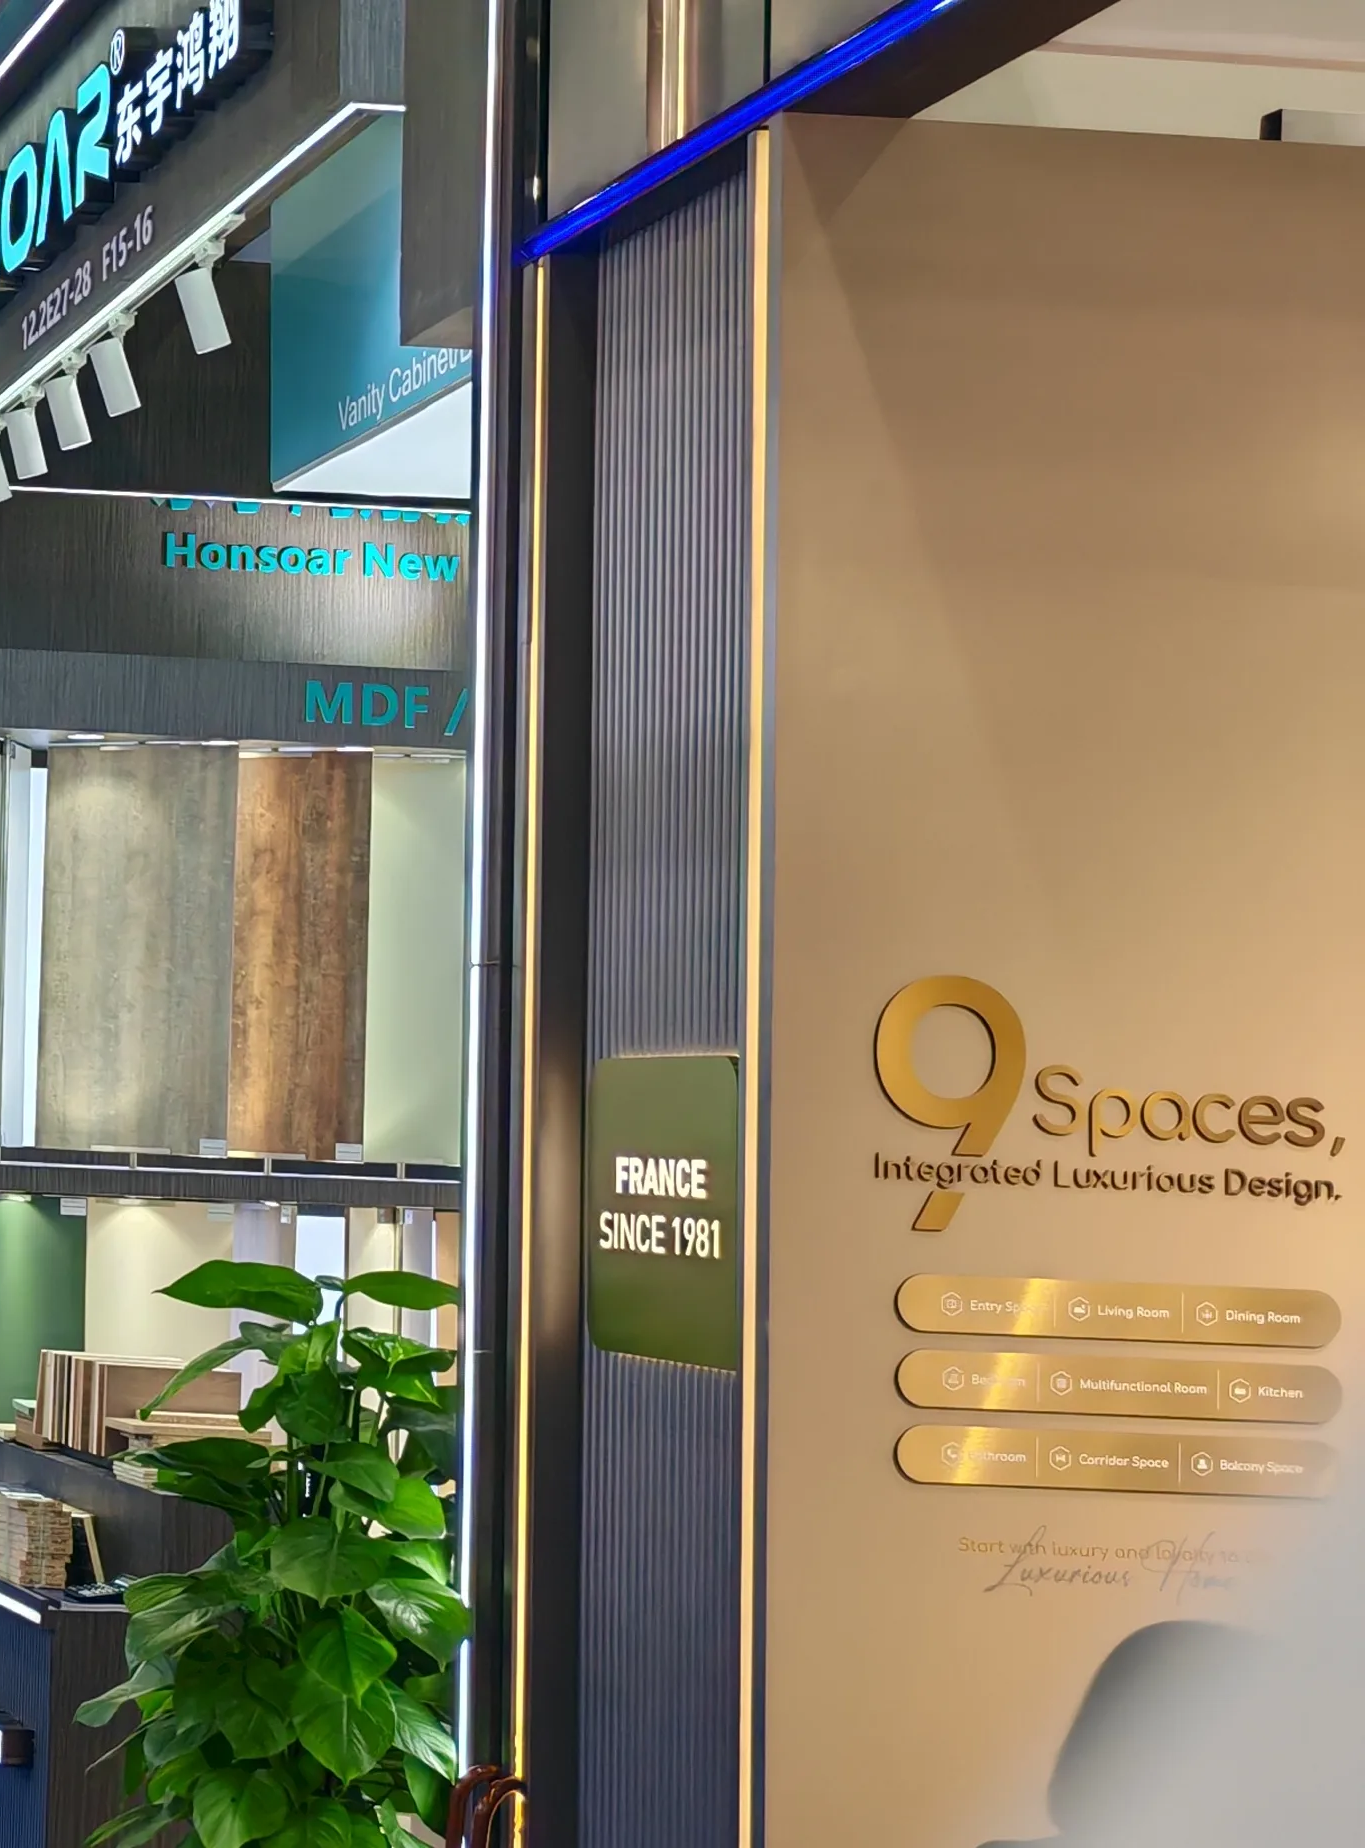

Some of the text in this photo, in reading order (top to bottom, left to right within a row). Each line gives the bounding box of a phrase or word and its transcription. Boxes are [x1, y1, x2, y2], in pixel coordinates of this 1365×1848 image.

[115, 0, 240, 166] 东宇鸿翔
[21, 204, 155, 351] 12.2E27-28 F15-16
[338, 382, 386, 431] Vanity
[164, 531, 460, 582] Honsoar New
[305, 679, 429, 729] MDF
[615, 1156, 708, 1200] FRANCE
[874, 1152, 1343, 1208] Integrated Luxurious Design.
[599, 1210, 721, 1260] SINCE 1981
[970, 1300, 1003, 1315] Entry
[1097, 1306, 1170, 1321] Living Room
[1225, 1310, 1301, 1325] Dining Room
[1079, 1378, 1208, 1395] Multifunctional Room
[1257, 1385, 1303, 1399] Kitchen
[971, 1450, 1027, 1463] throom
[1078, 1453, 1169, 1471] Corridor Space
[1219, 1459, 1304, 1476] Balcony Space
[957, 1536, 1005, 1554] Start
[1051, 1541, 1110, 1561] luxury
[982, 1524, 1130, 1597] Luxurious
